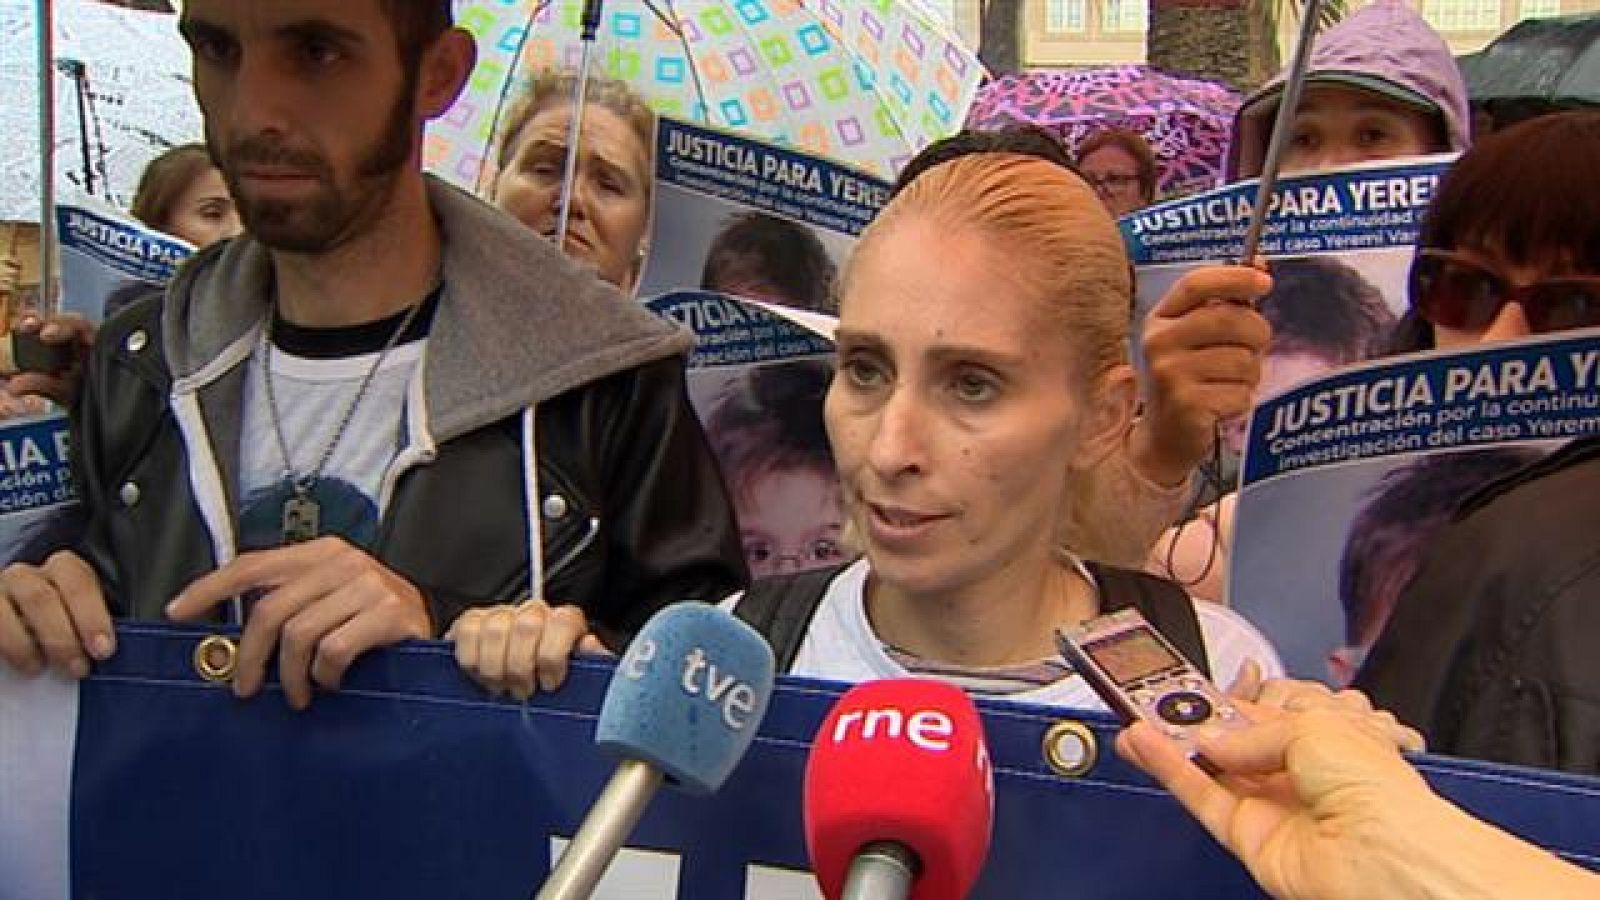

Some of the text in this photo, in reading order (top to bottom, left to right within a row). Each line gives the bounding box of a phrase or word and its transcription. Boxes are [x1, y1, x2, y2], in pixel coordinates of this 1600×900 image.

[666, 129, 758, 175] JUSTICIA
[763, 154, 823, 193] PARA
[1131, 194, 1250, 236] JUSTICIA
[1349, 174, 1439, 211] YERE
[1264, 373, 1433, 442] JUSTICIA
[1444, 355, 1557, 402] PARA
[1437, 404, 1476, 431] por
[1480, 400, 1500, 419] la
[0, 436, 50, 471] IA
[1426, 424, 1463, 446] del
[1469, 421, 1521, 441] caso
[680, 648, 756, 731] tve
[832, 707, 955, 751] rne
